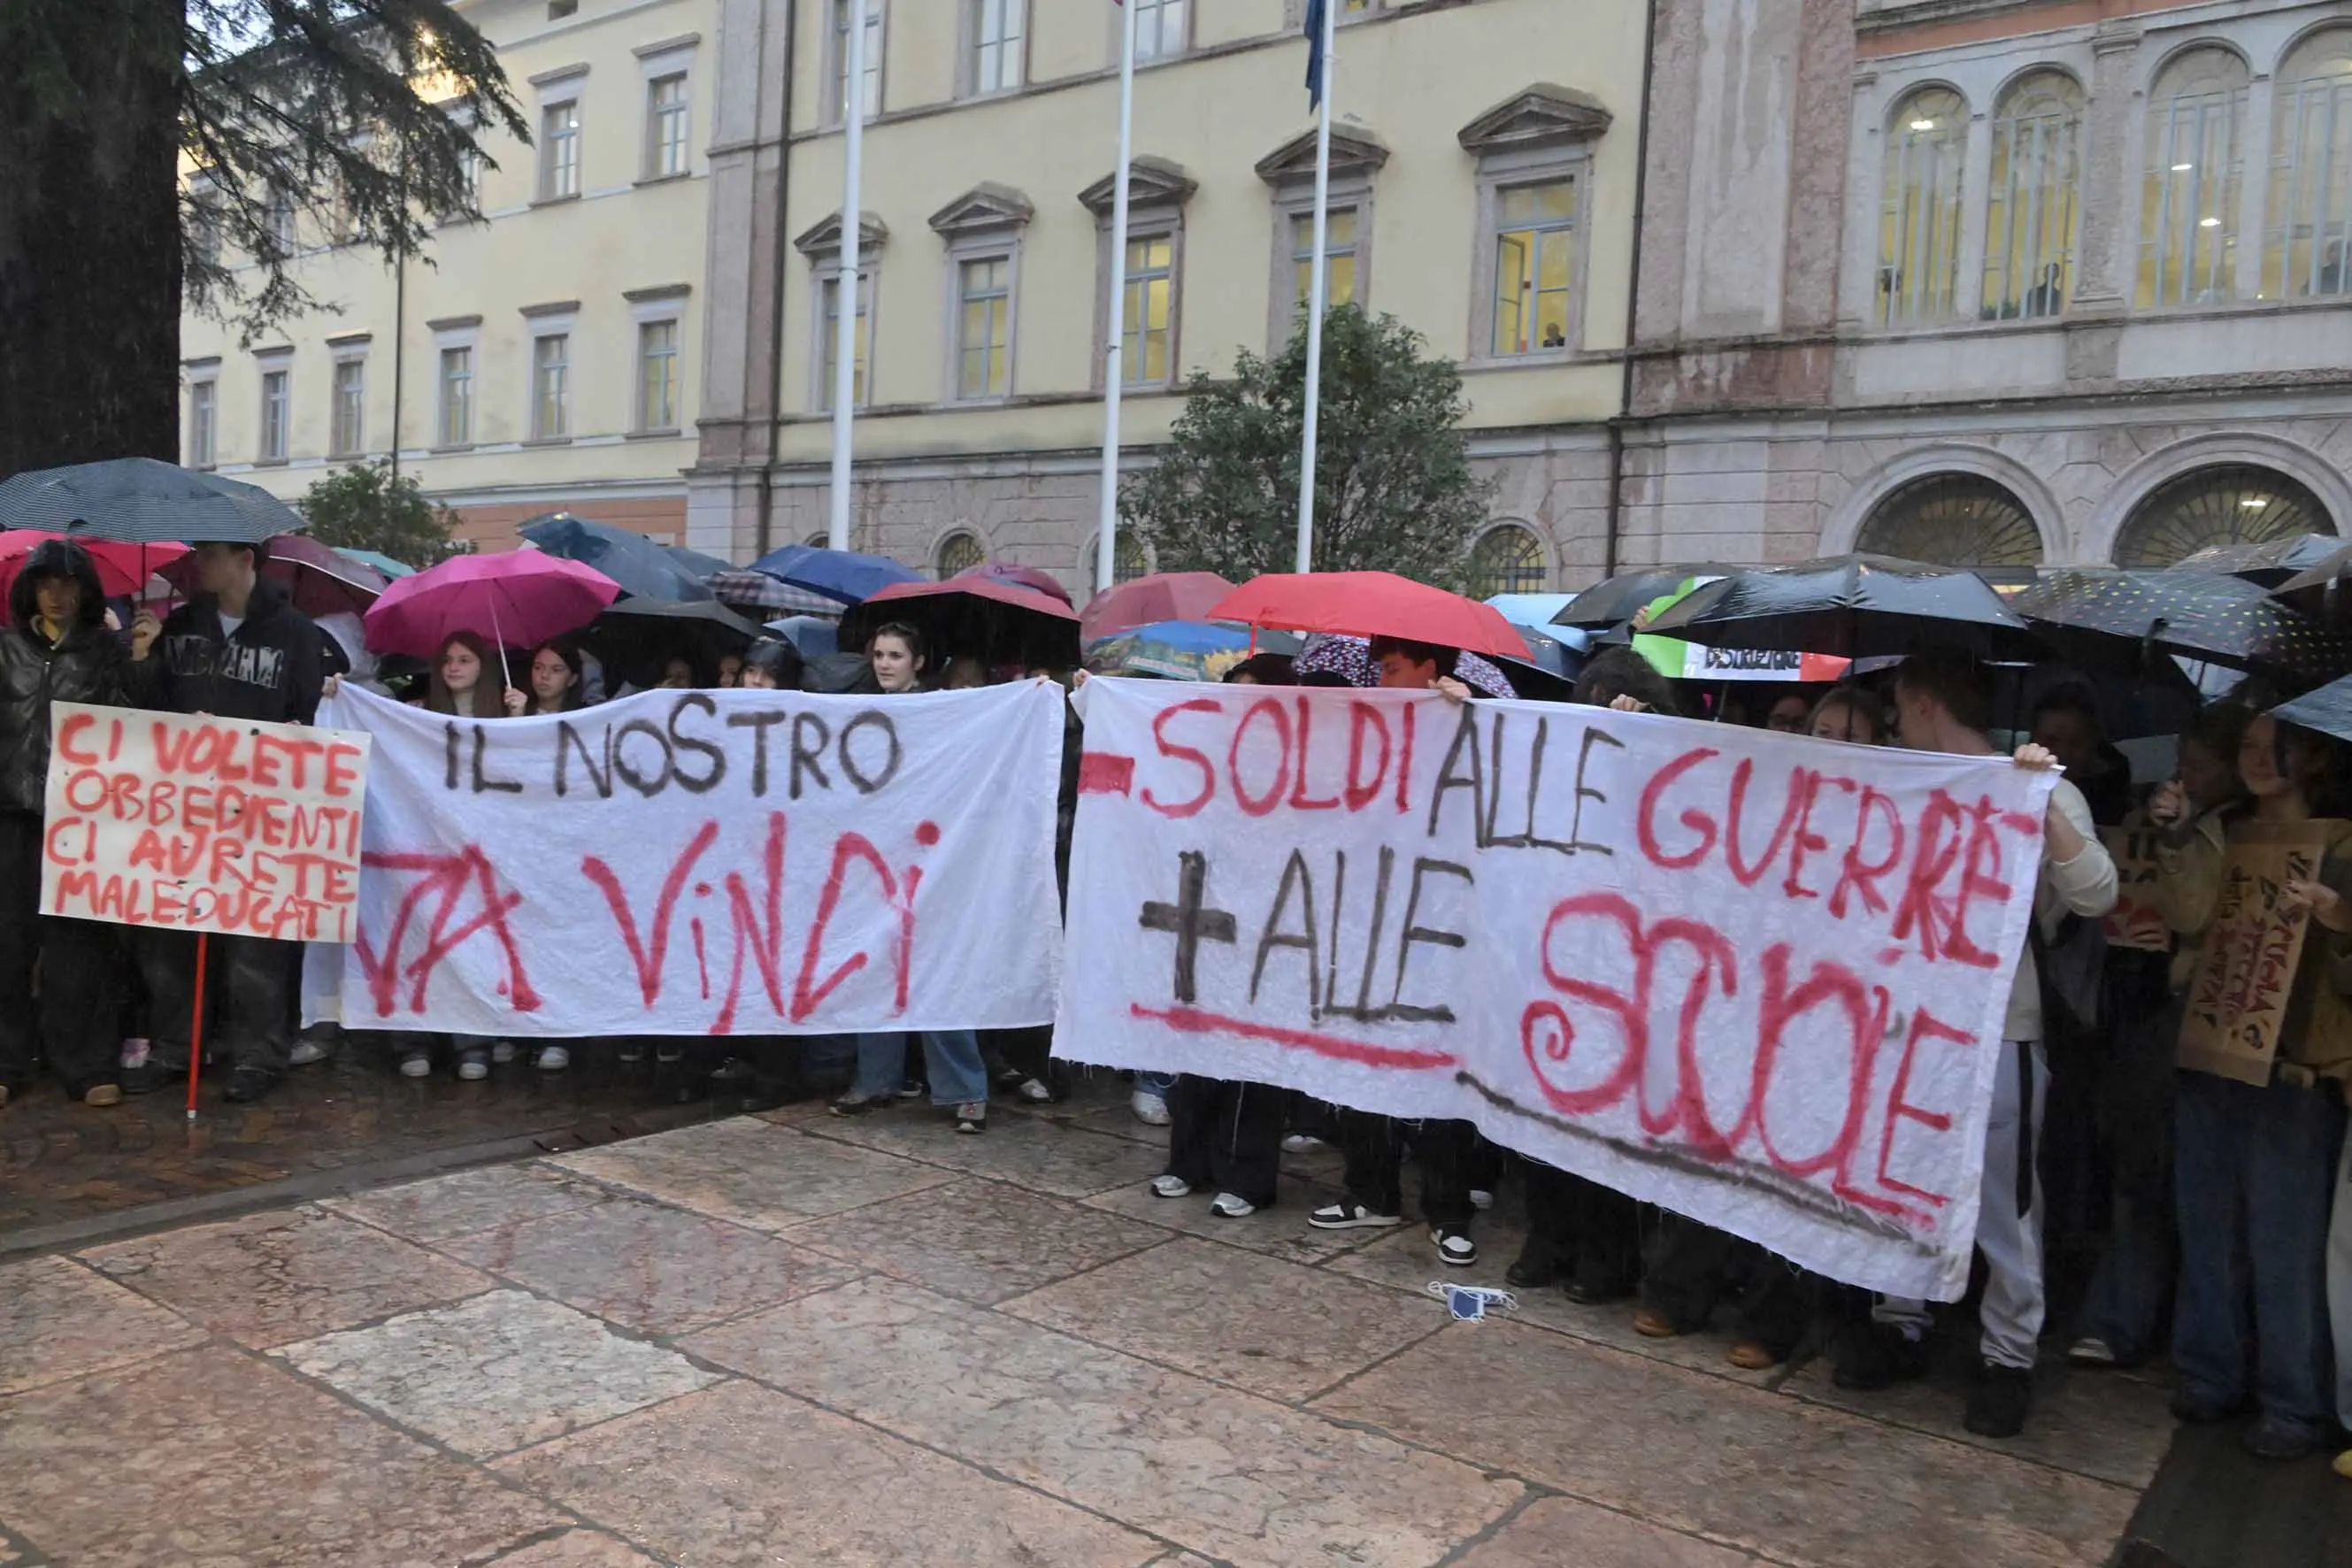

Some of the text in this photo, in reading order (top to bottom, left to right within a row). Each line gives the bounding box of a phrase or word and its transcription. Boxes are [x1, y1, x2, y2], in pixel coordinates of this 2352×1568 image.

[58, 713, 362, 796] CI VOLETE
[444, 693, 903, 800] IL NOSTRO
[65, 768, 361, 857] OBBEDIENTI
[1140, 694, 1415, 819] SOLDI
[1428, 702, 1626, 856] ALLE
[1637, 747, 2040, 969] GUERRE
[47, 817, 357, 903] CI AVRETE
[54, 870, 348, 941] MALEDUCATI
[1249, 844, 1474, 1025] ALLE
[1520, 890, 1979, 1227] SCUOLE
